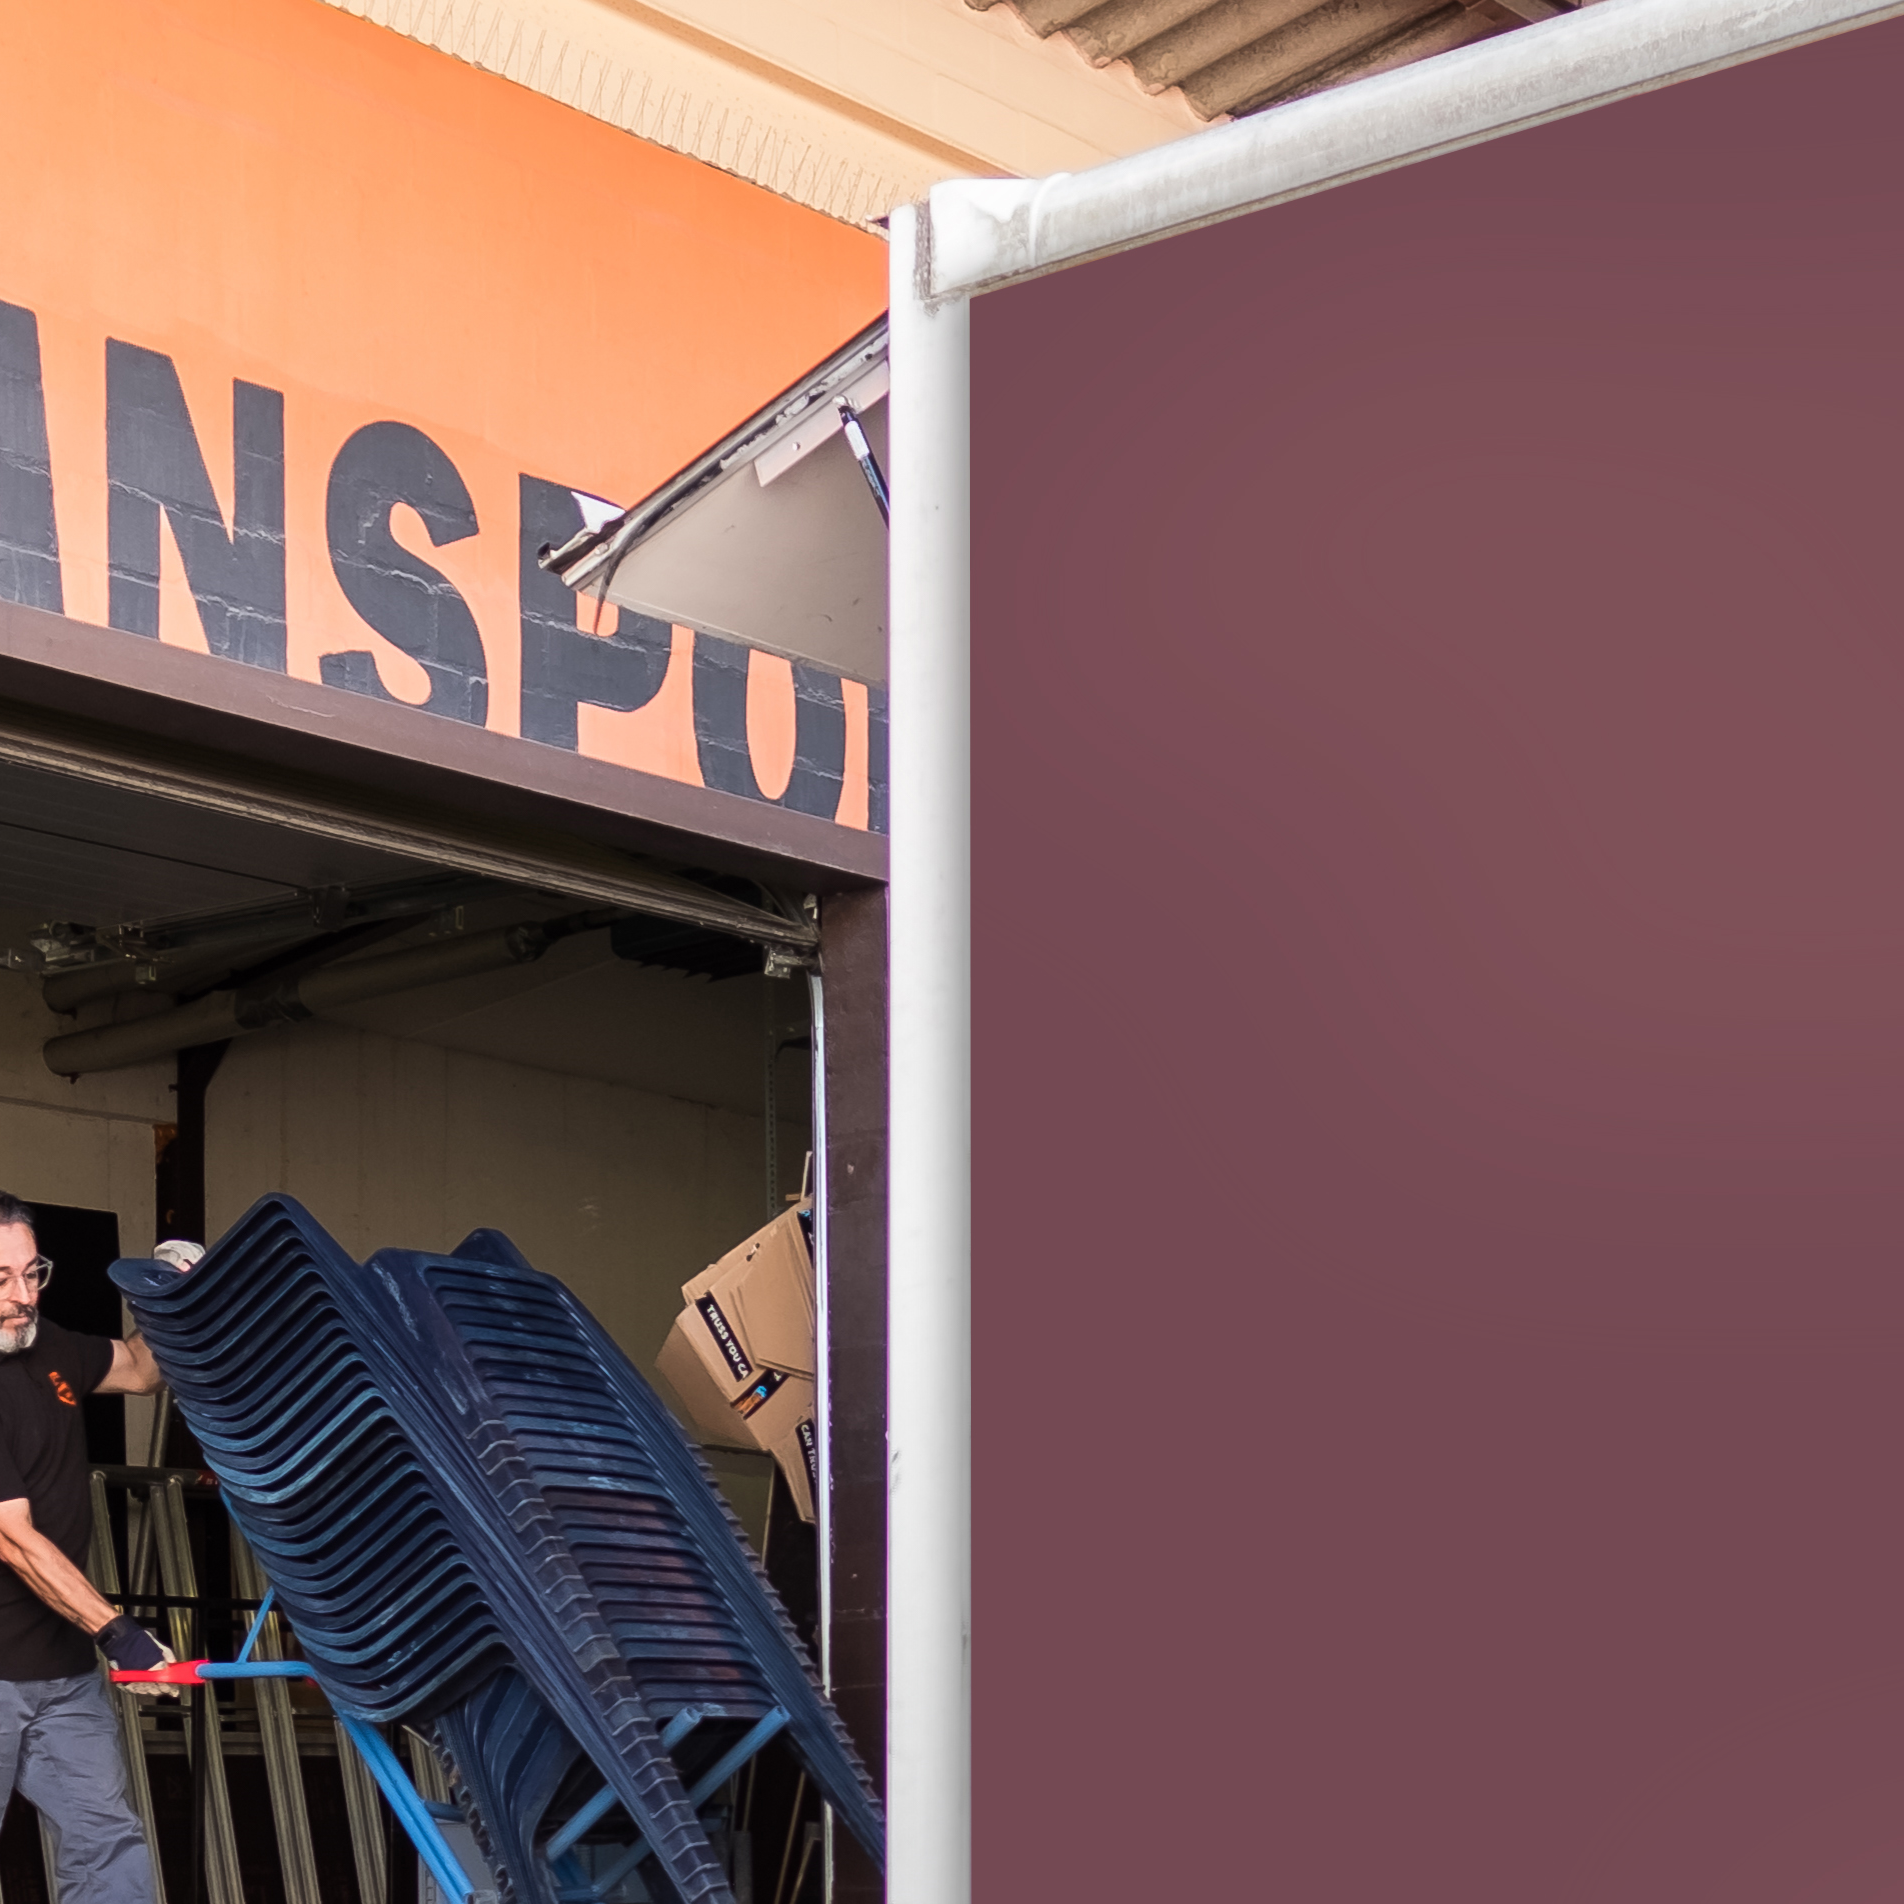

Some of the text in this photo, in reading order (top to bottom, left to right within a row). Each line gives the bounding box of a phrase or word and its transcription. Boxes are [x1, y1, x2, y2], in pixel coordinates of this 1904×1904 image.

[706, 1304, 729, 1340] TRUSS
[726, 1338, 742, 1363] YOU
[801, 1424, 813, 1447] CAN
